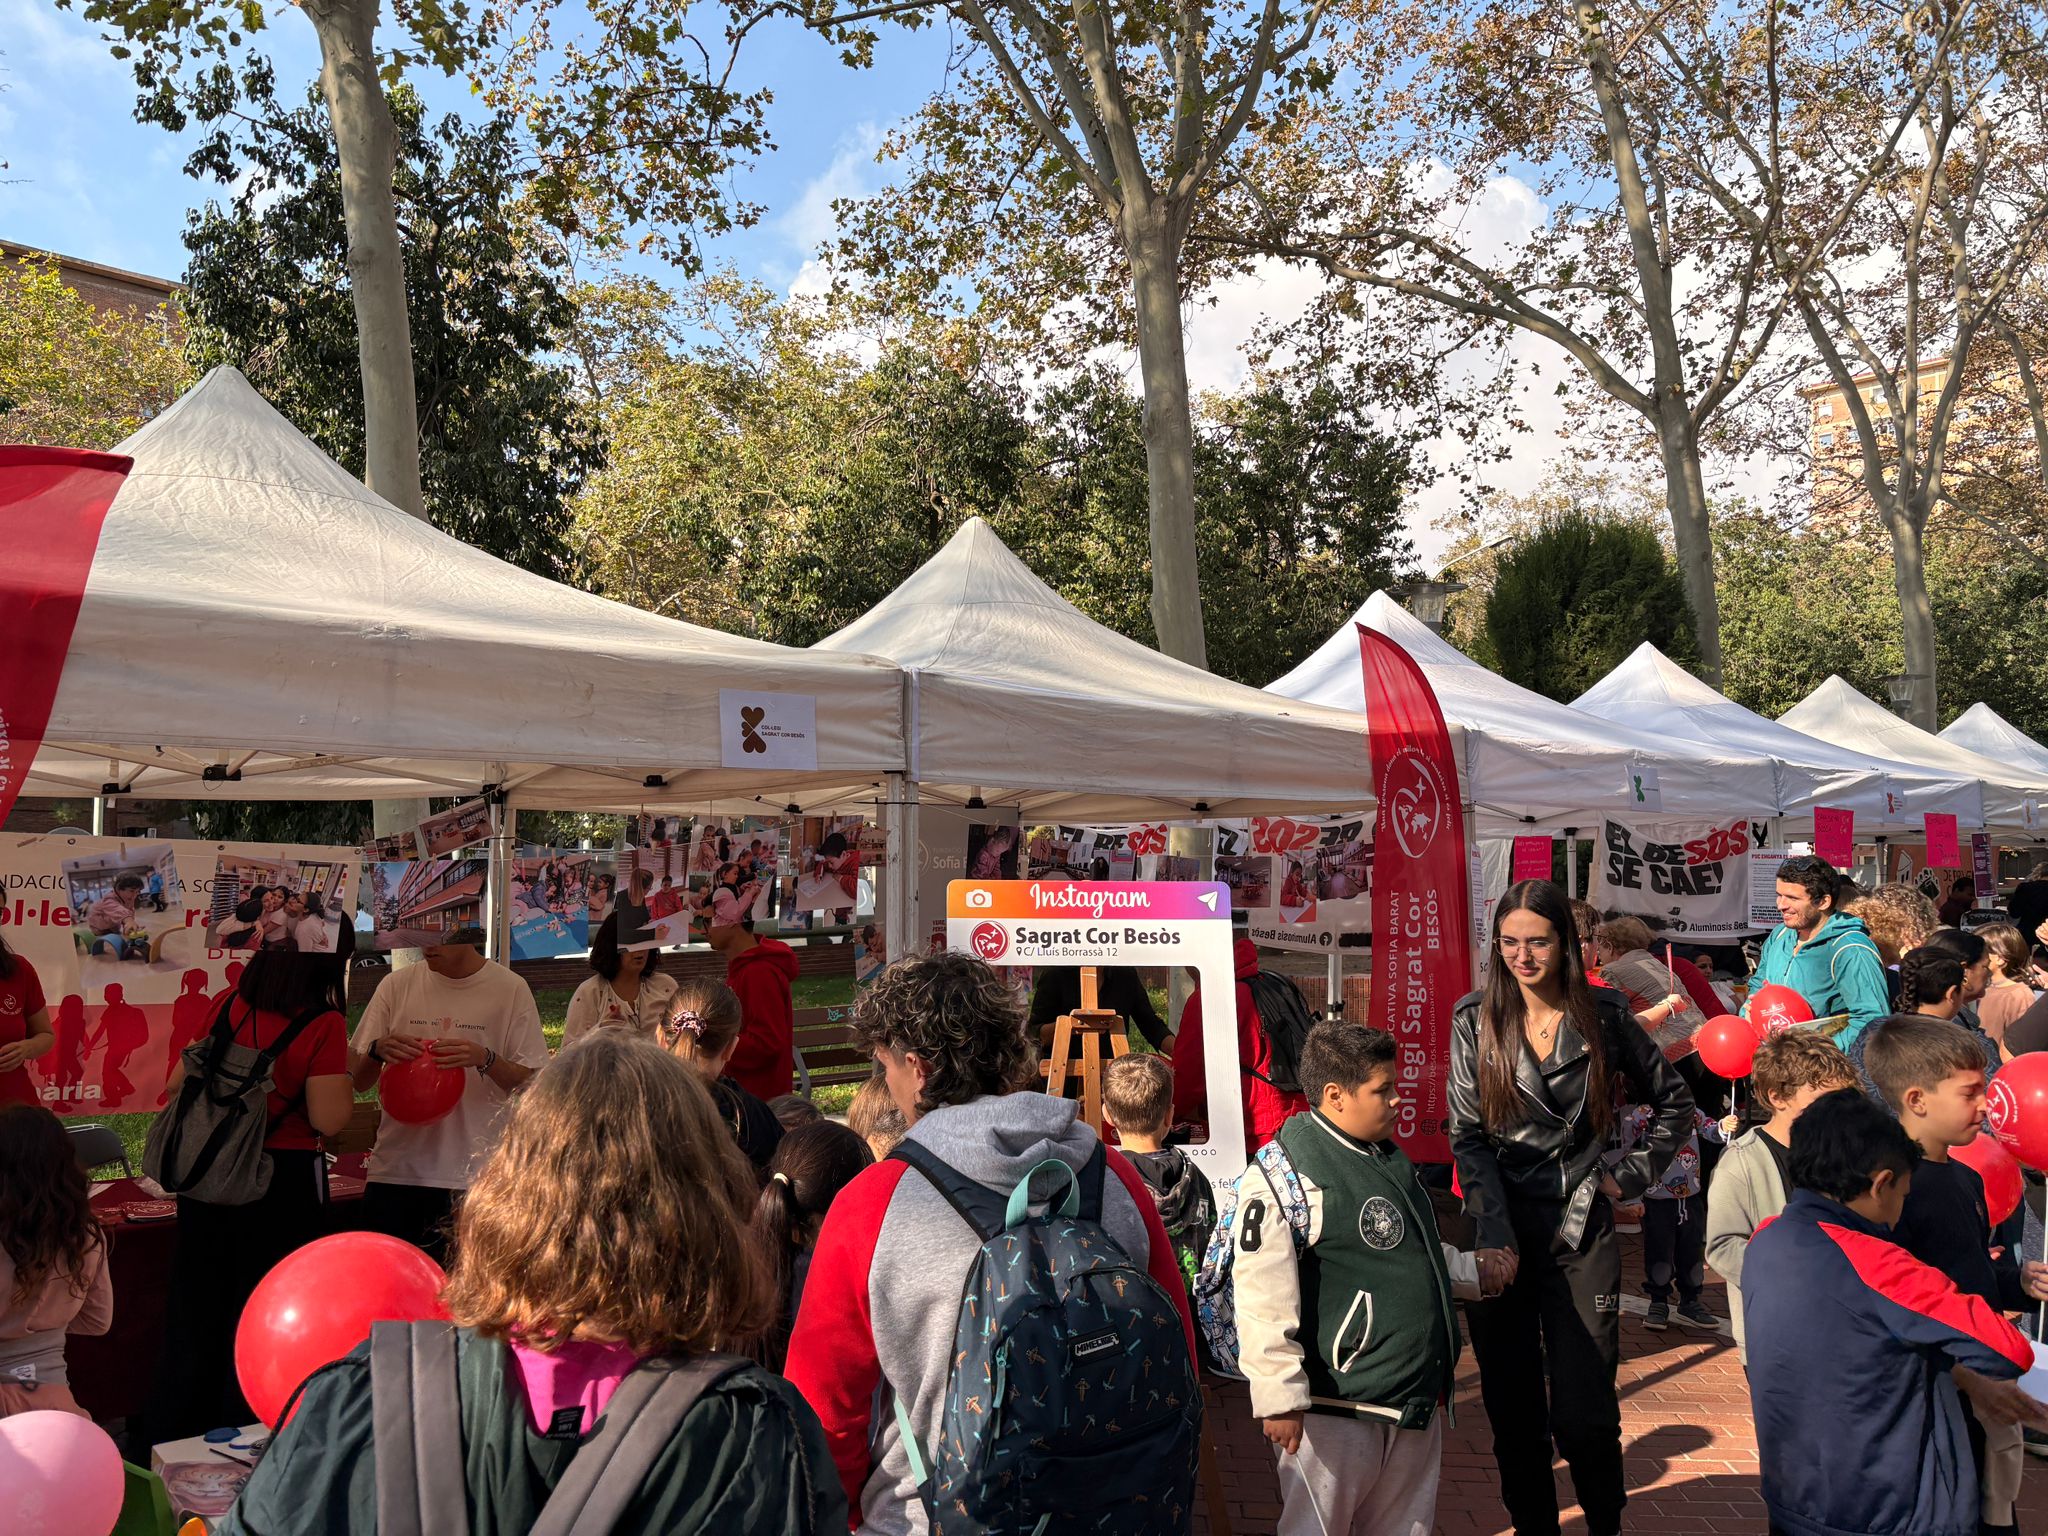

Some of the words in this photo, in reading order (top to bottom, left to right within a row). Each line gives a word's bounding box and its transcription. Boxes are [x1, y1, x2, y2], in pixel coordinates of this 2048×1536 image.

[1605, 818, 1640, 858] EL
[1606, 851, 1645, 890] SE
[1649, 861, 1725, 897] CAE!
[1029, 882, 1151, 919] Instagram
[1389, 889, 1400, 935] BARAT
[1404, 892, 1422, 938] Cor
[1423, 889, 1440, 949] BESÒS
[1016, 928, 1082, 948] Sagrat
[1086, 929, 1120, 944] Cor
[1124, 928, 1181, 945] Besòs
[1689, 922, 1734, 932] Aluminosis
[1733, 920, 1749, 930] Bes
[1024, 947, 1036, 957] C/
[1037, 946, 1061, 957] Lluís
[1062, 946, 1104, 957] Borrassà
[1105, 947, 1119, 957] 12
[1388, 939, 1398, 980] SOFIA
[1386, 981, 1397, 1037] CATIVA
[1401, 946, 1427, 1034] Sagrat
[1397, 1042, 1426, 1138] Col·legi
[1218, 1177, 1235, 1189] fel
[1240, 1199, 1267, 1253] 8
